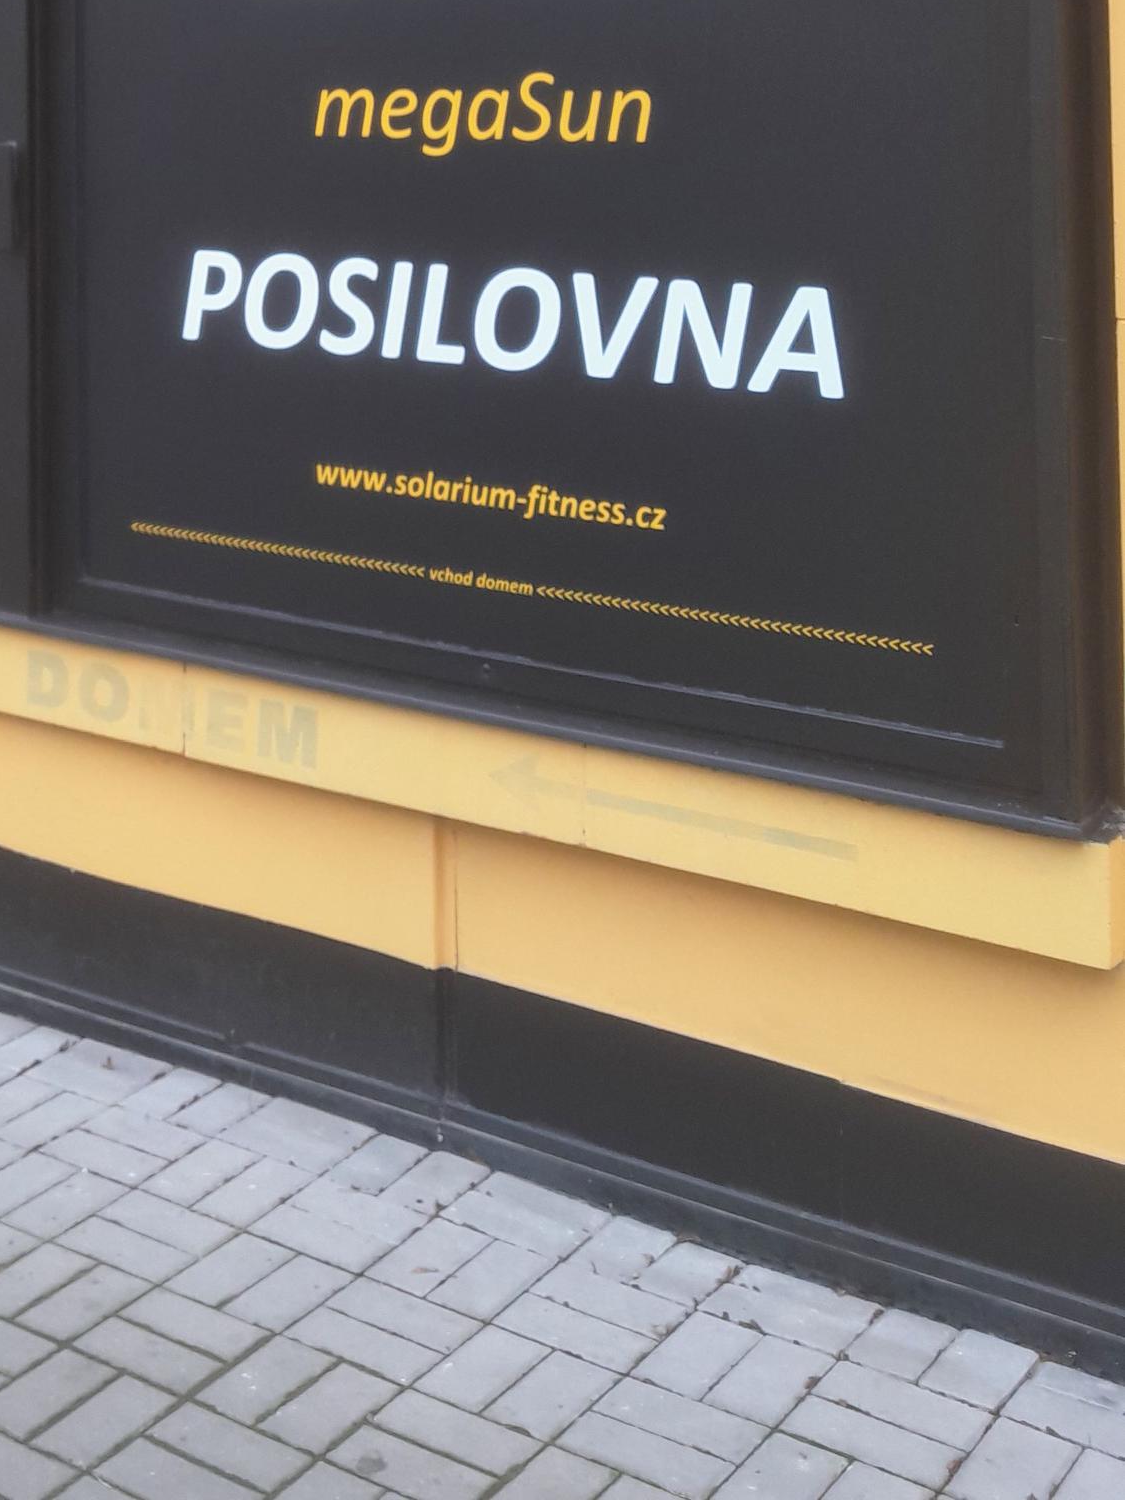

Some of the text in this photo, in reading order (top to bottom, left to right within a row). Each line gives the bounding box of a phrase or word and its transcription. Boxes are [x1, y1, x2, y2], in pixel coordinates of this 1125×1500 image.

[315, 72, 652, 158] megaSun
[181, 249, 846, 400] POSILOVNA
[316, 463, 667, 531] www.solarium-fitness.cz
[429, 565, 534, 597] vchod domem
